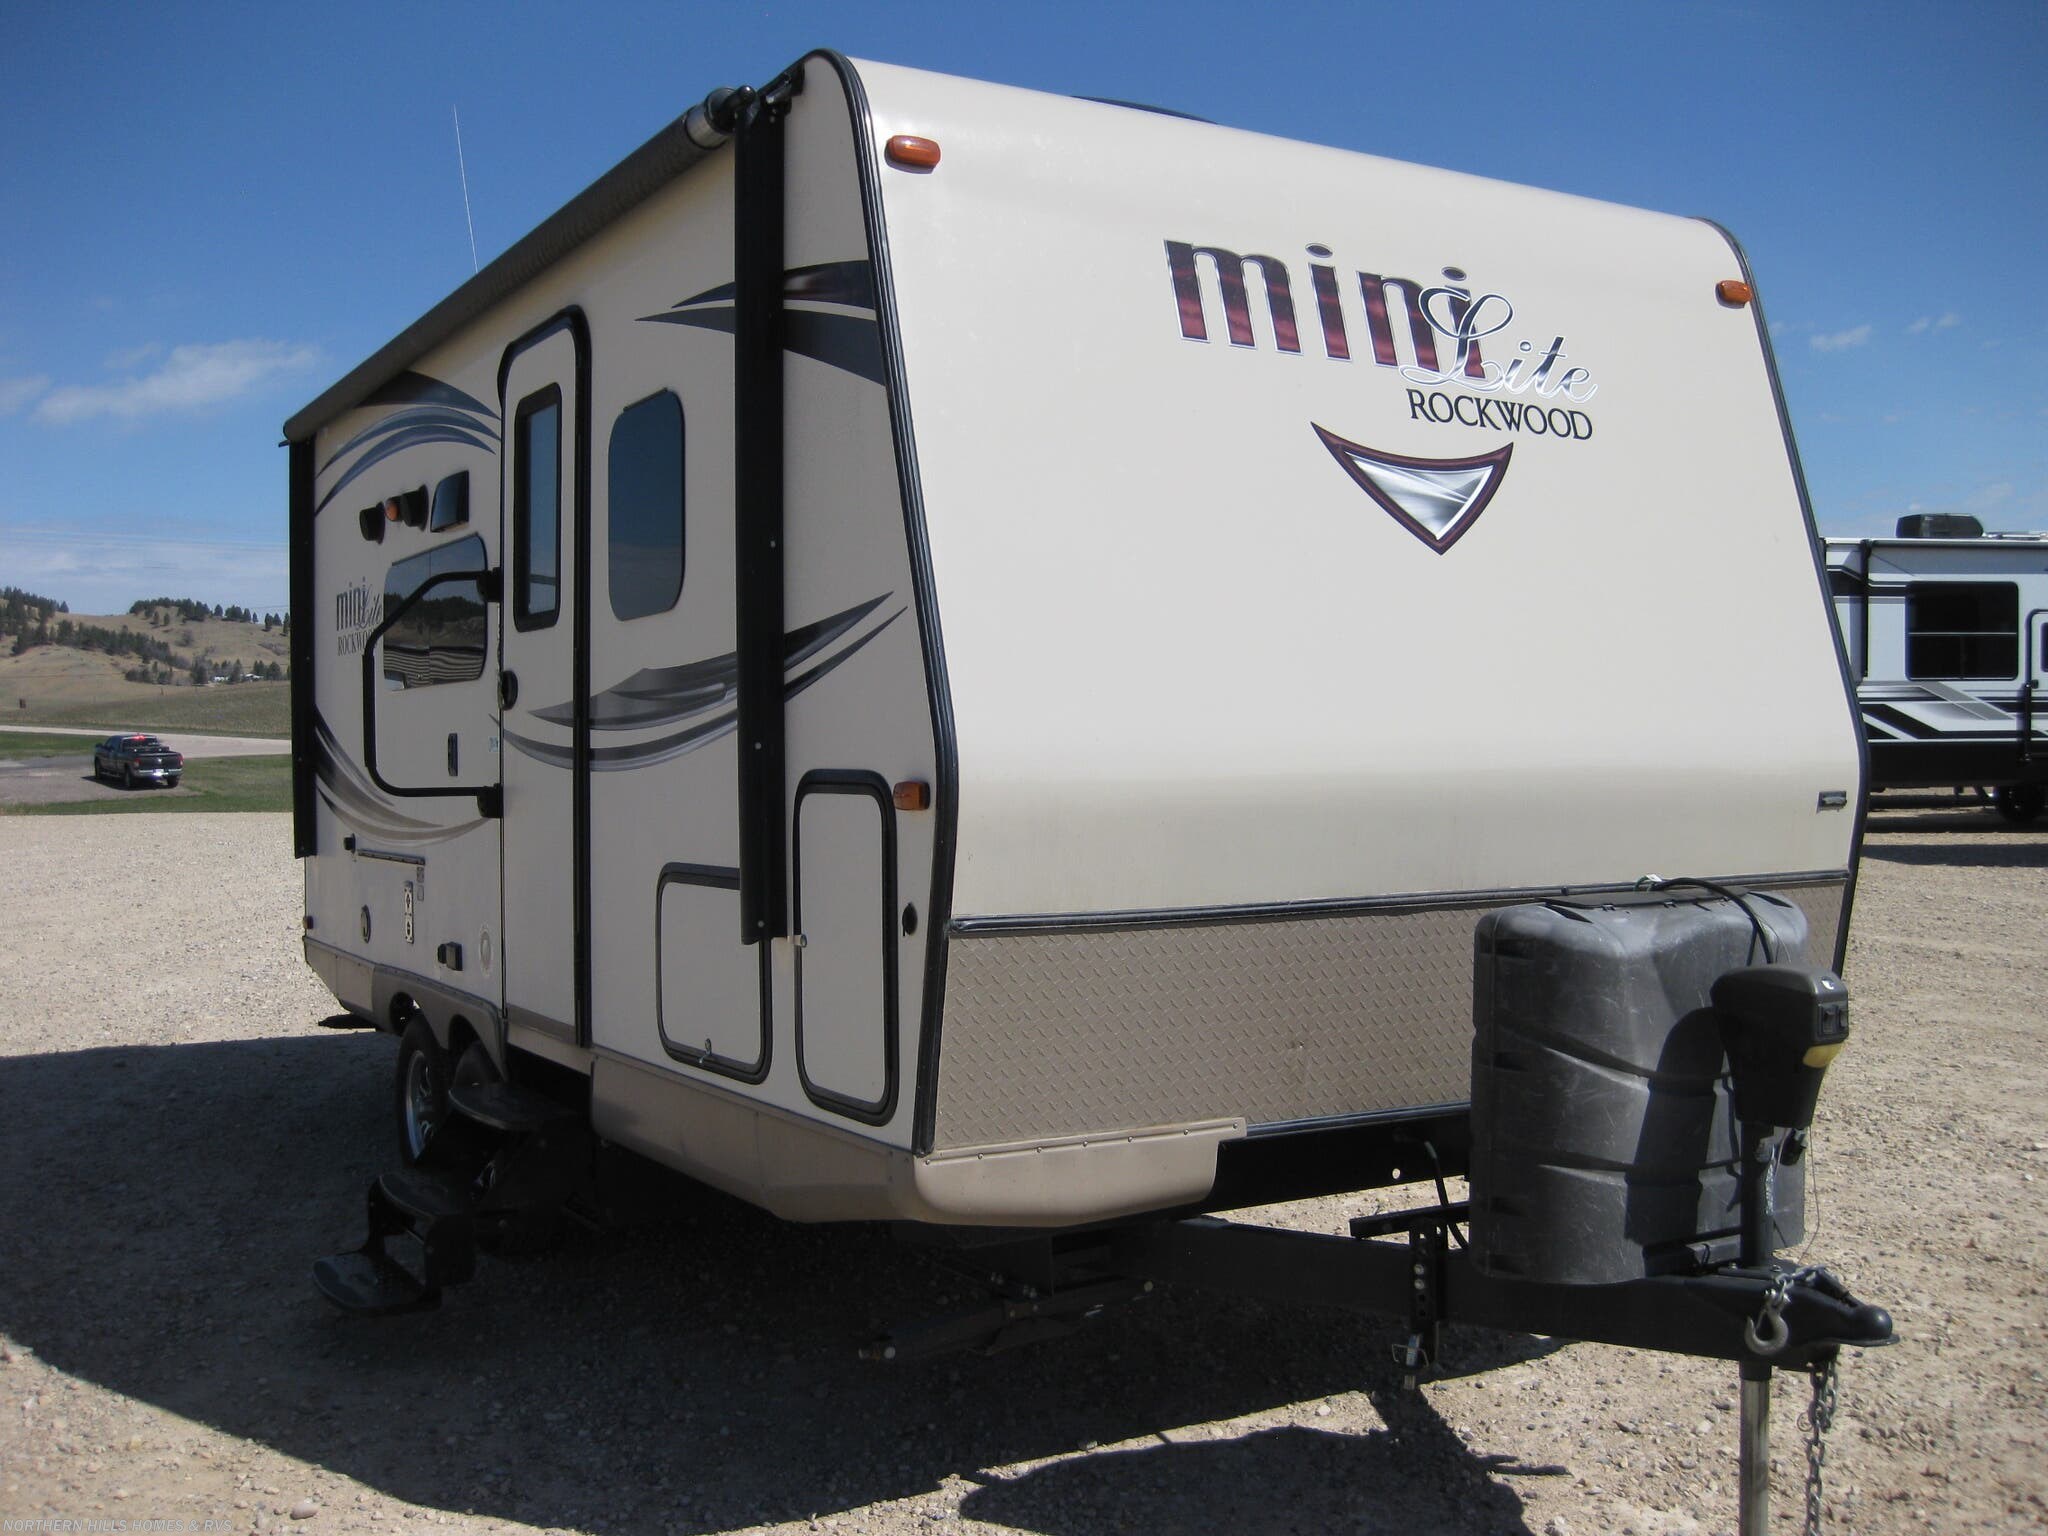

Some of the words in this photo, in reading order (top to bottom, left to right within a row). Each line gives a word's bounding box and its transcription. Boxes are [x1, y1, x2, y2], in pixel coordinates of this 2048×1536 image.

[1163, 239, 1487, 381] mini
[1400, 286, 1597, 402] Lite
[1406, 389, 1593, 440] ROCKWOOD
[336, 576, 368, 631] mini
